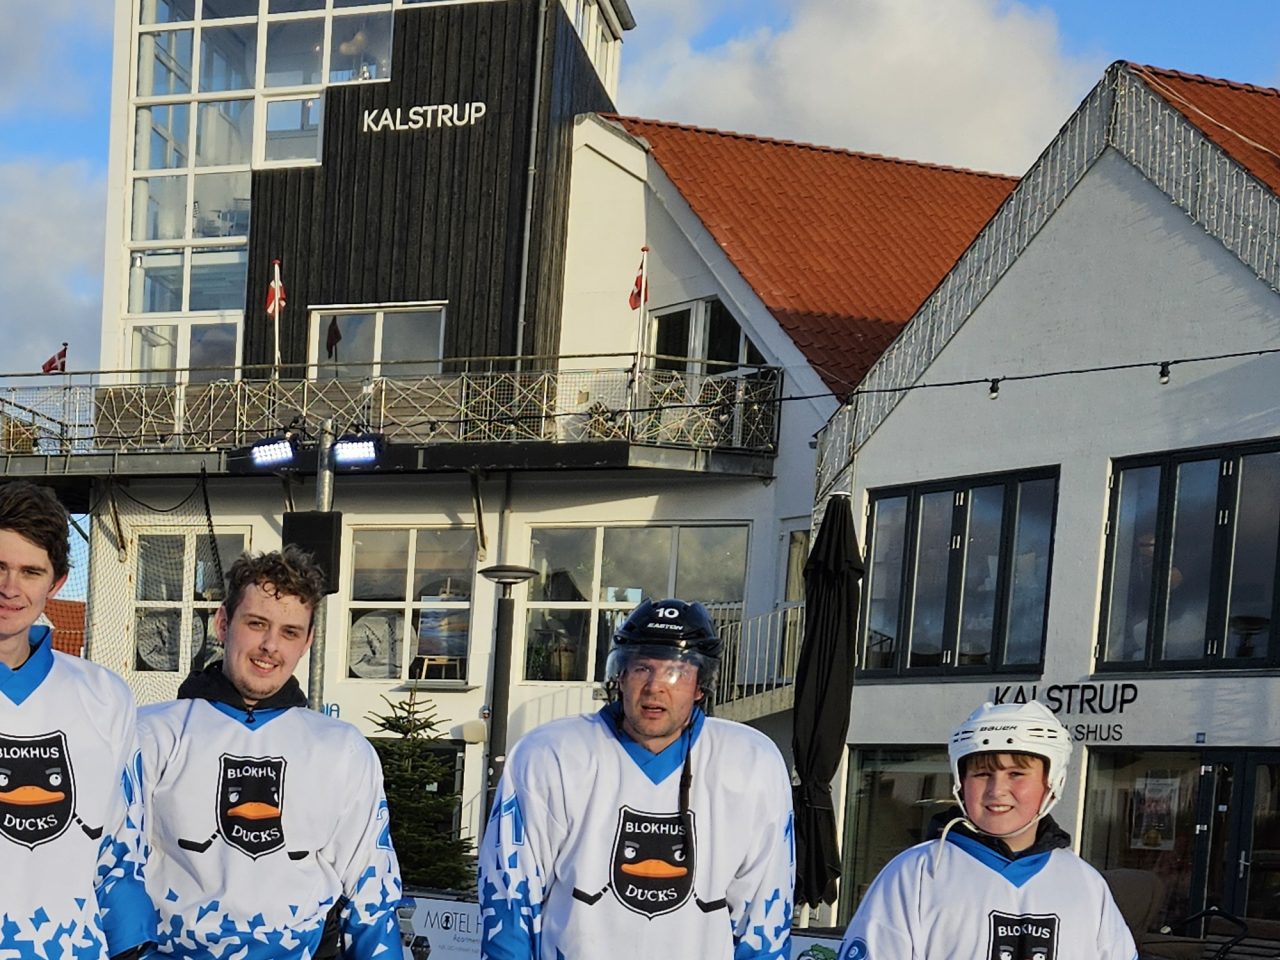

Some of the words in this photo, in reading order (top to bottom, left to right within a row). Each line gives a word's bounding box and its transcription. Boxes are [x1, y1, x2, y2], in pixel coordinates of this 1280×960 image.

[363, 102, 486, 133] KALSTRUP
[655, 607, 680, 619] 10
[647, 622, 684, 631] EASTON
[1062, 723, 1123, 742] SHUS
[3, 813, 58, 831] DUCKS
[625, 821, 686, 835] BLOKHUS
[231, 824, 281, 843] DUCKS
[624, 883, 678, 902] DUCKS
[424, 909, 472, 933] MOTEL
